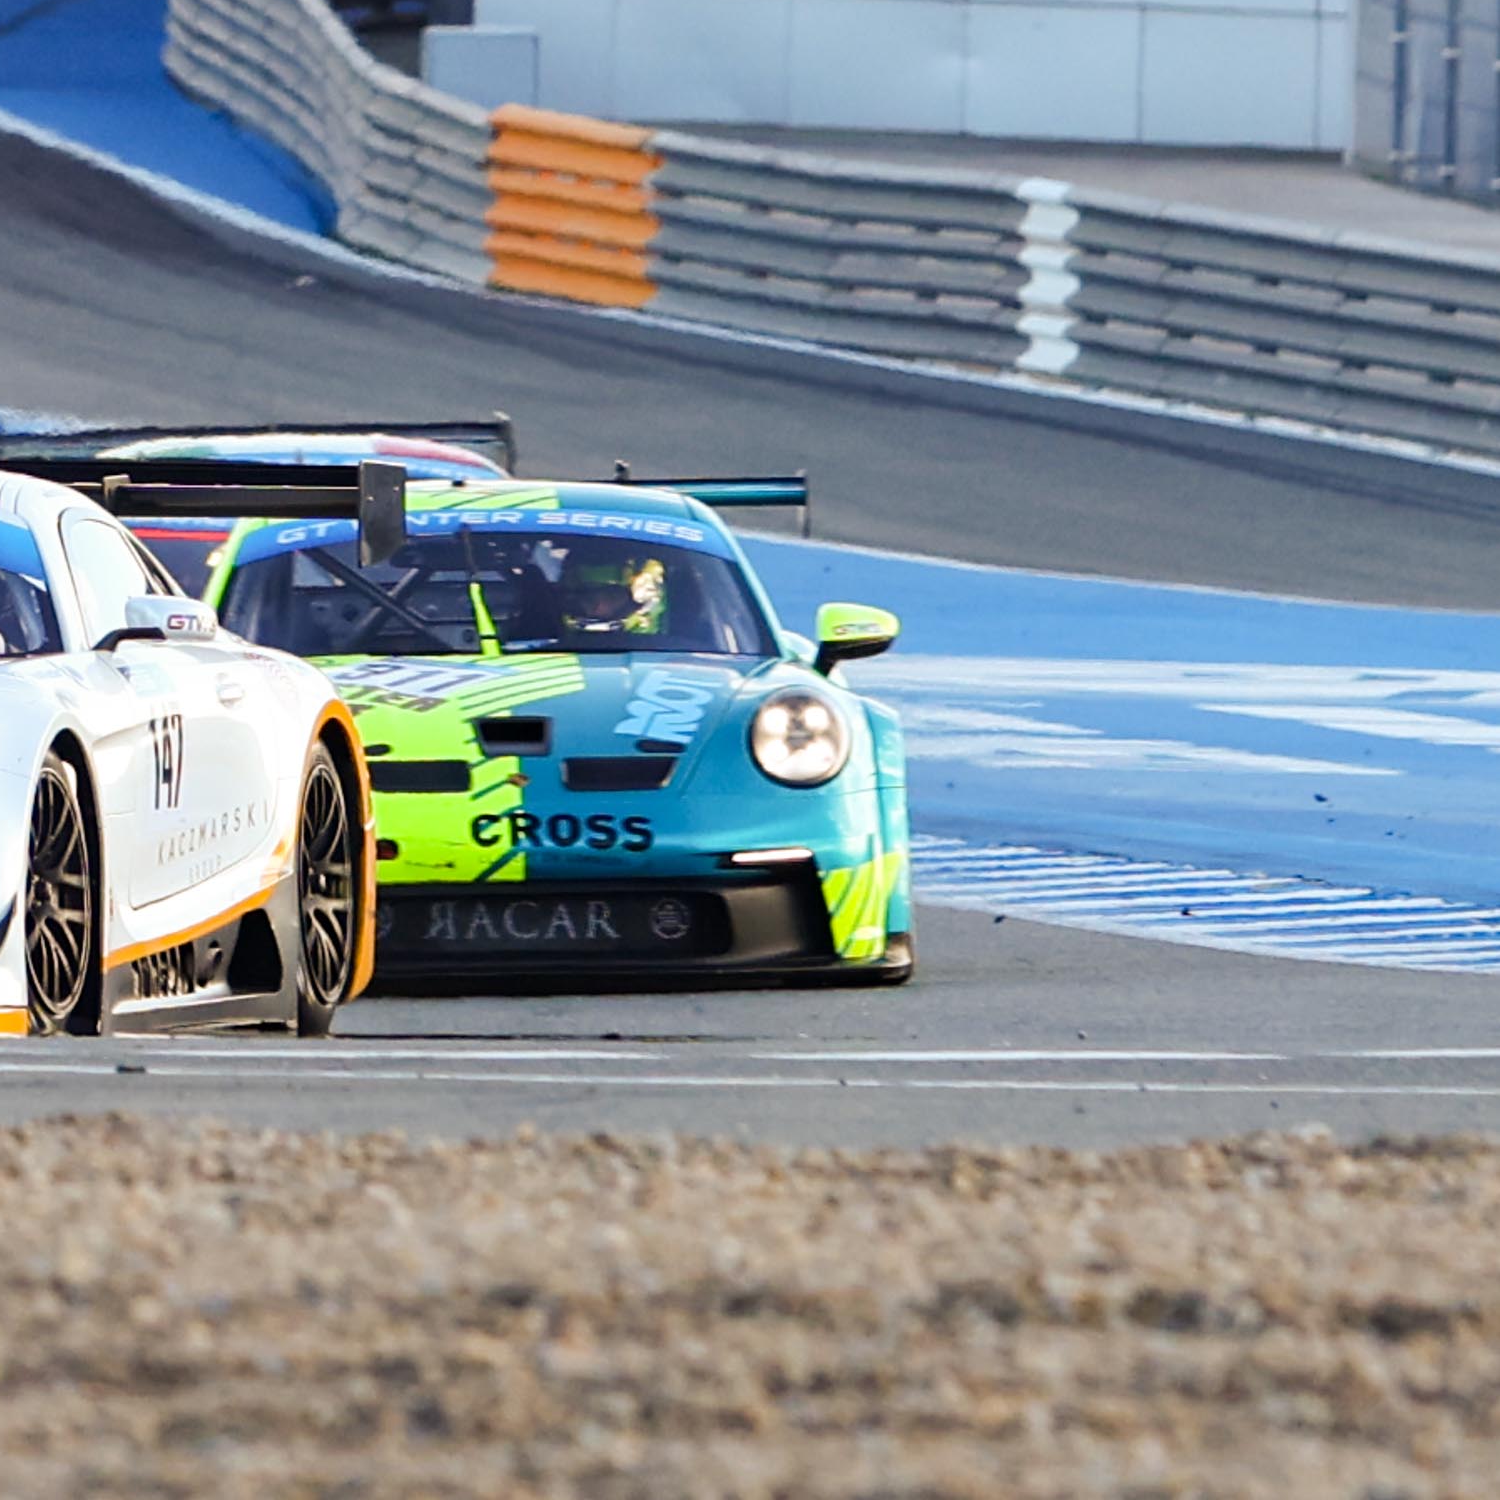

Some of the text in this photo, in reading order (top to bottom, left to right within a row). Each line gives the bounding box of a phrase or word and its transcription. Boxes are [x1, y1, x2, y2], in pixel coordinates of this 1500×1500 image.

[275, 520, 344, 544] GT
[536, 510, 705, 542] SERIES
[333, 662, 487, 694] 911
[149, 713, 184, 810] 147
[156, 799, 269, 866] KACZMARSKI
[470, 813, 655, 852] CROSS
